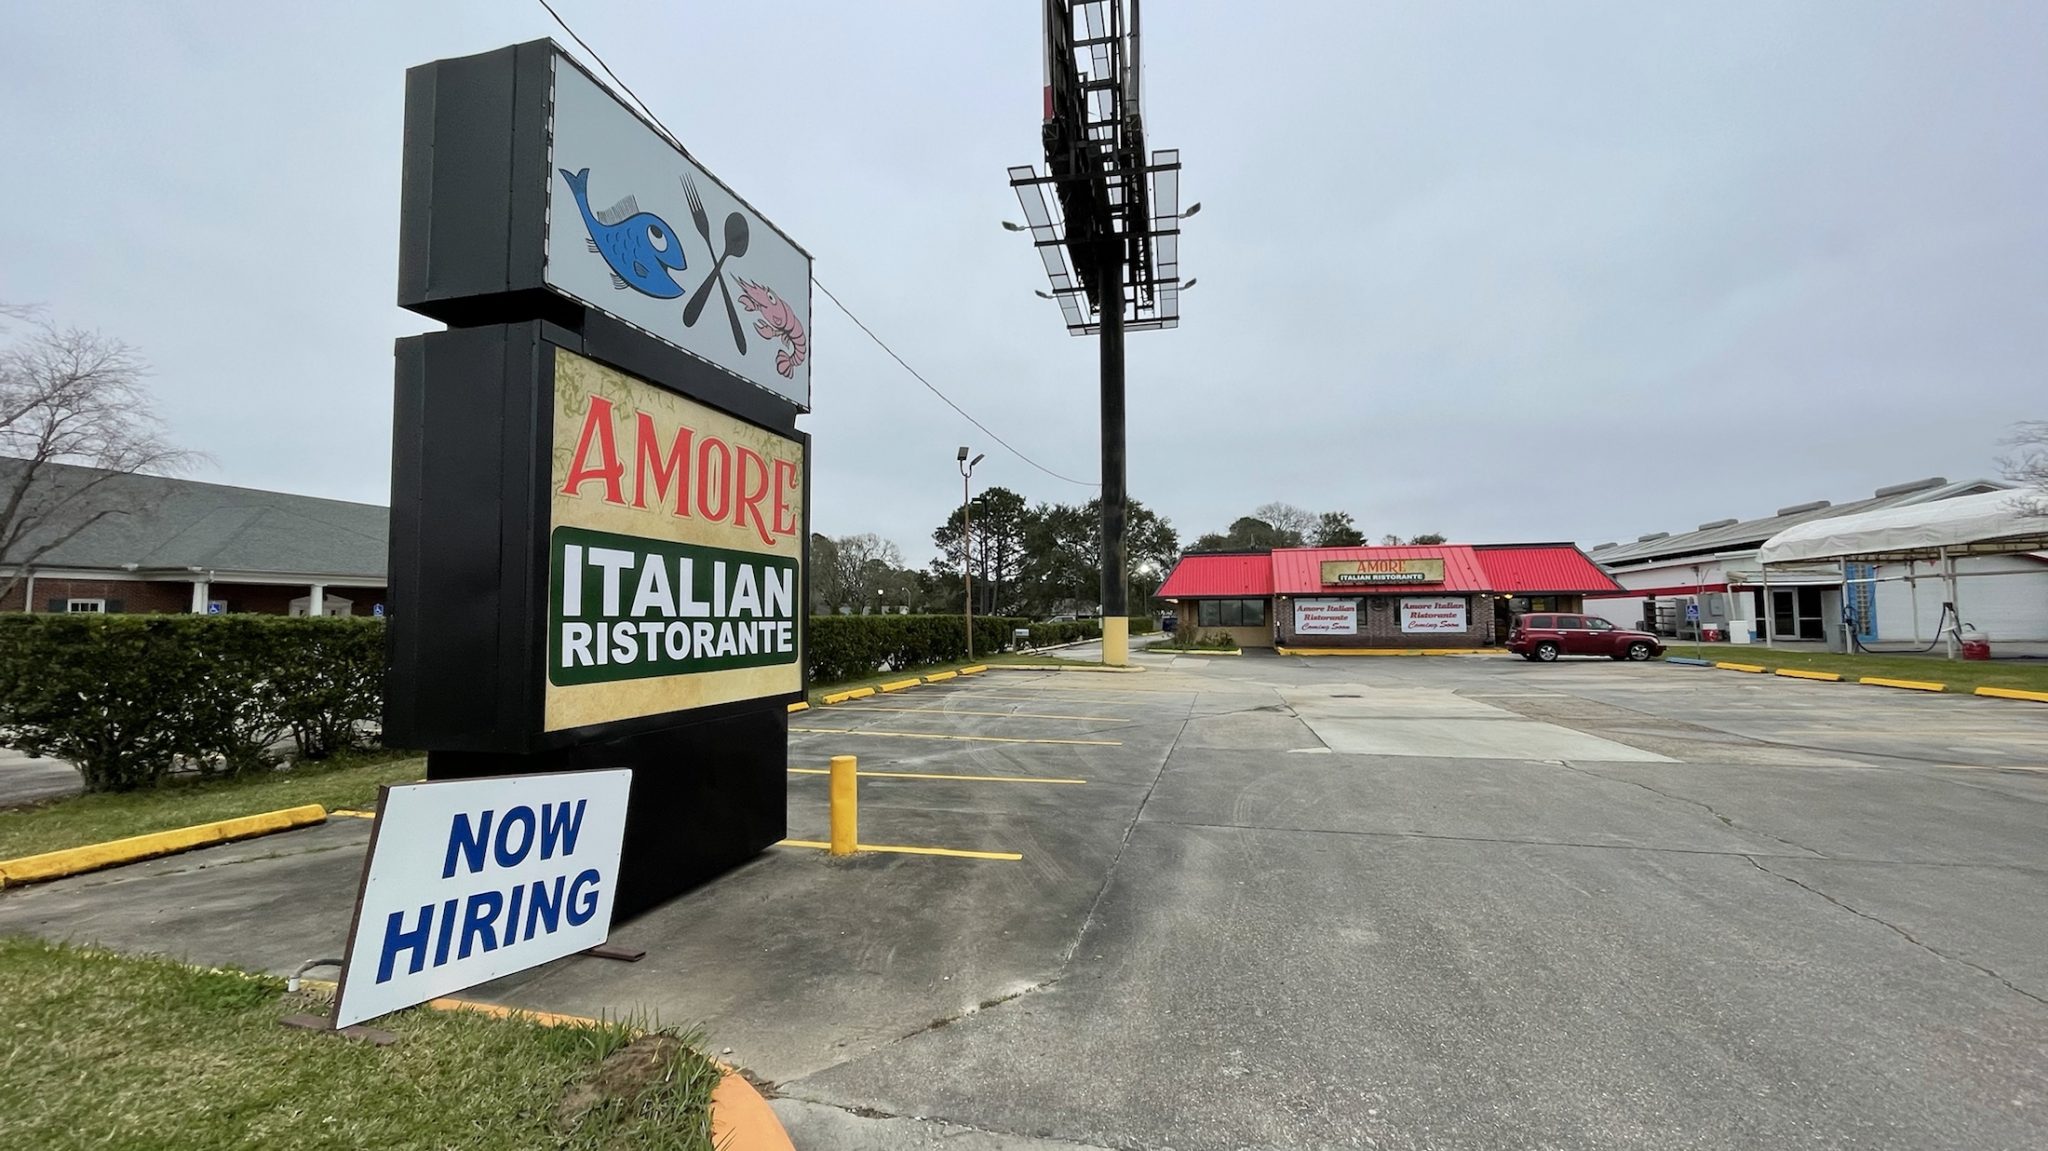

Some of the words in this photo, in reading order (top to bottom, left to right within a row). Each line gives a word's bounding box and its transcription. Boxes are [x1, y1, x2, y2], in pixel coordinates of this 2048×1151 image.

[559, 394, 797, 546] AMORE
[562, 544, 793, 618] ITALIAN
[1357, 560, 1406, 573] AMORE
[561, 620, 793, 668] RISTORANTE
[1301, 622, 1330, 631] Coming
[1331, 622, 1350, 630] Soon
[1408, 620, 1437, 629] Coming
[1440, 620, 1459, 628] Soon
[441, 799, 587, 879] NOW
[375, 868, 601, 984] HIRING
